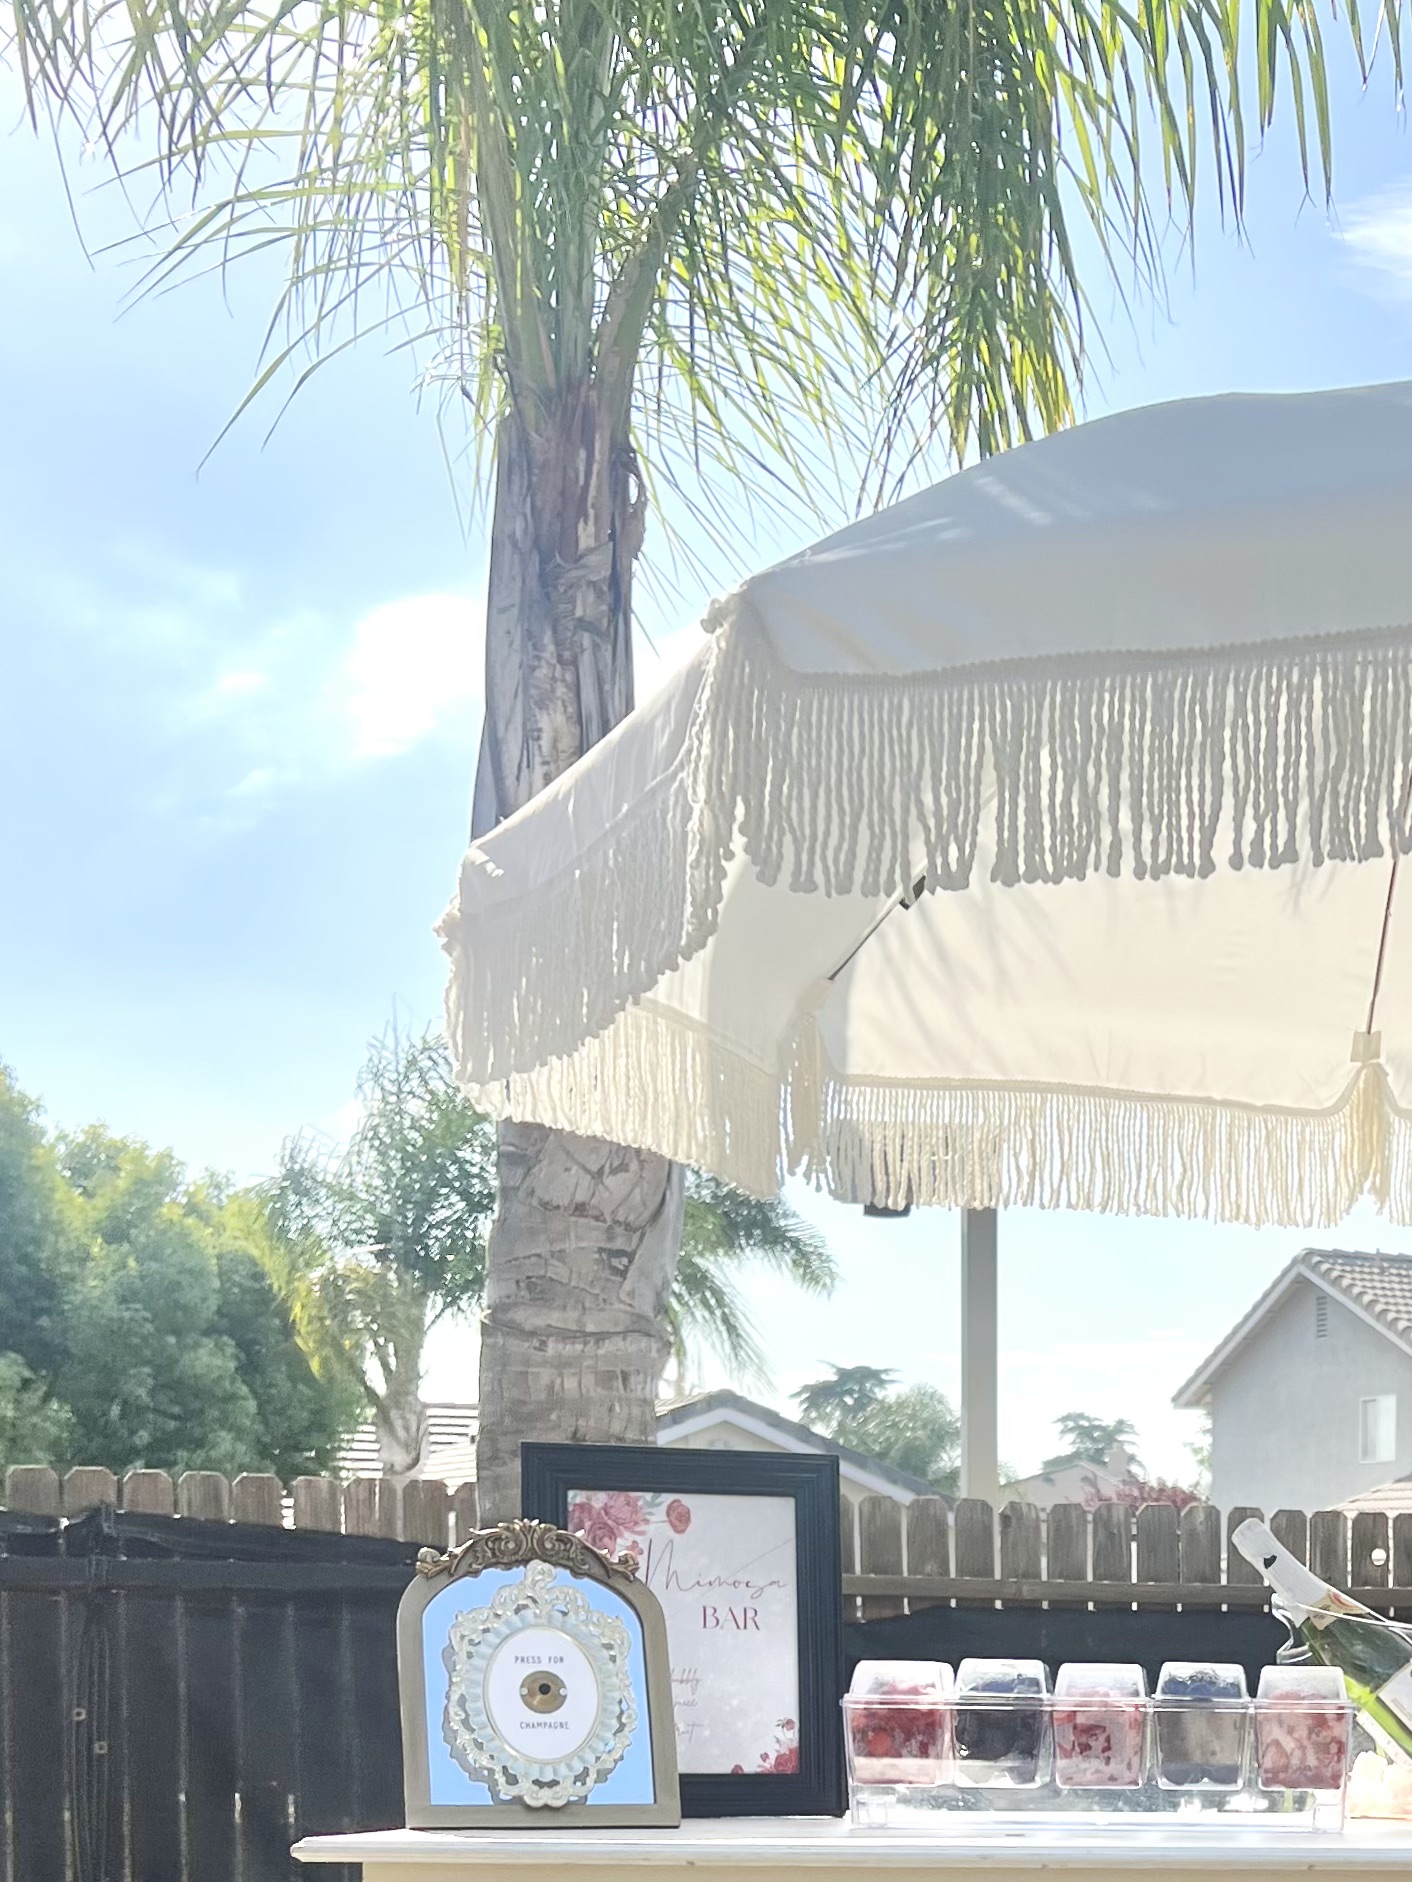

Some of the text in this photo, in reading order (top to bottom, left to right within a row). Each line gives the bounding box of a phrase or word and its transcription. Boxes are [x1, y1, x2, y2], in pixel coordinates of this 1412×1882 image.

[644, 1537, 788, 1600] Mimosa
[702, 1605, 760, 1631] BAR
[514, 1655, 565, 1665] PRESS FOR
[519, 1721, 570, 1730] CHAMPAGNE
